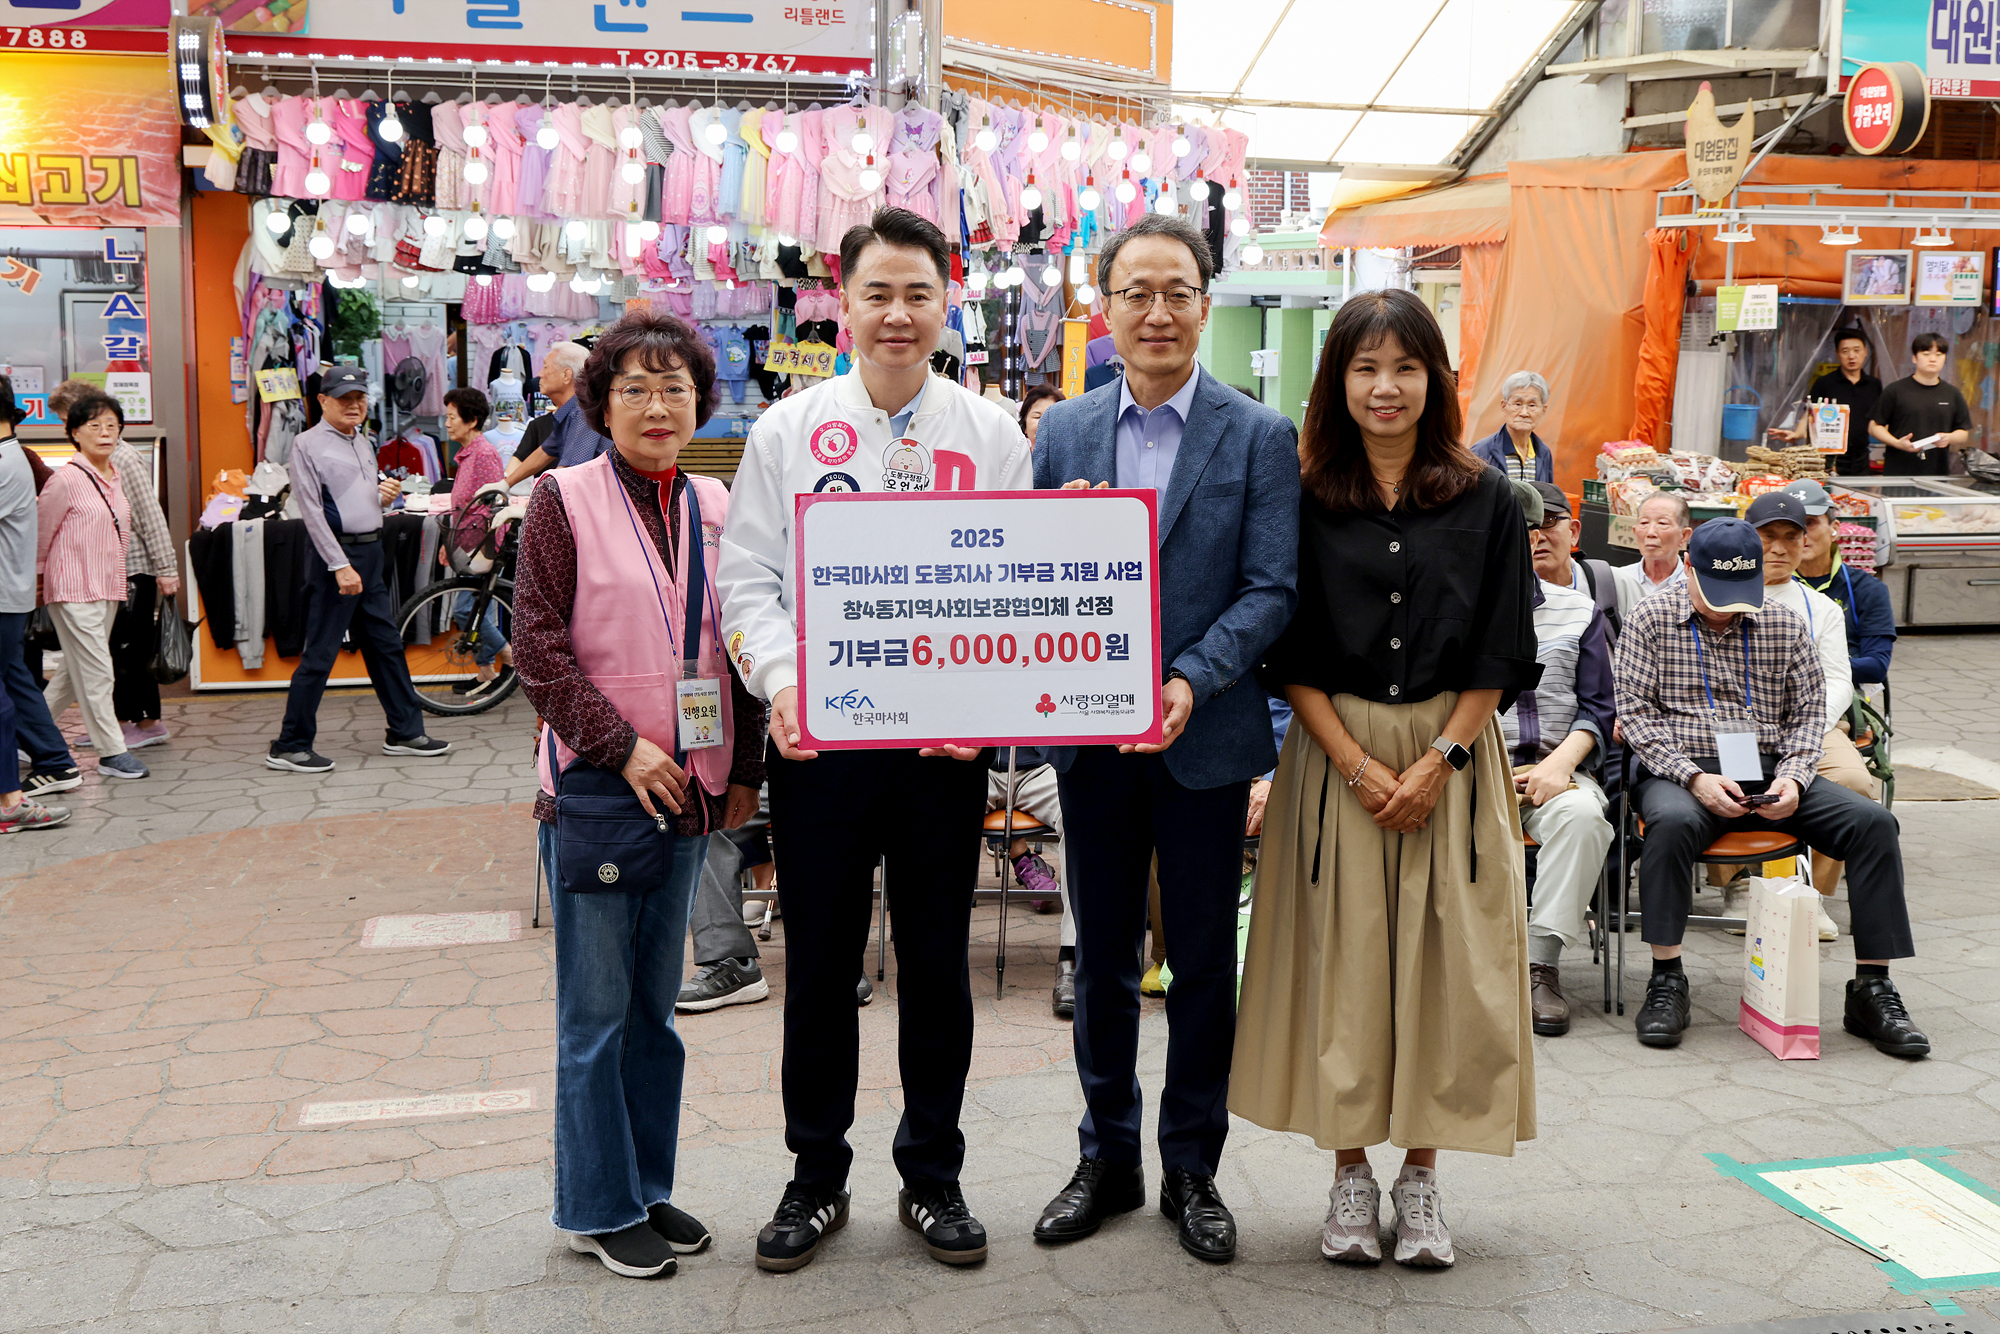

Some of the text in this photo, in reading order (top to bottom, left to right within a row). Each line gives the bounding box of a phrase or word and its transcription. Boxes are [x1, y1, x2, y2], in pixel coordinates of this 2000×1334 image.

[784, 7, 846, 25] 리틀랜드
[0, 28, 87, 48] 7888
[1932, 0, 2000, 64] 대원
[617, 50, 796, 72] T.905-3767
[1694, 137, 1739, 162] 대원닭집
[967, 290, 982, 298] SALE
[772, 350, 831, 372] 파격세일
[970, 352, 985, 362] SALE
[23, 398, 45, 419] 기
[950, 528, 1005, 548] 2025
[812, 560, 1143, 586] 한국마사회 도봉지사 기부금 지원 사업
[843, 596, 1114, 620] 창4동지역사회보장협의체 선정
[825, 689, 875, 717] KRA
[1059, 694, 1135, 710] 사랑의열매
[683, 705, 717, 720] 진행요원
[852, 711, 909, 725] 한국마사회
